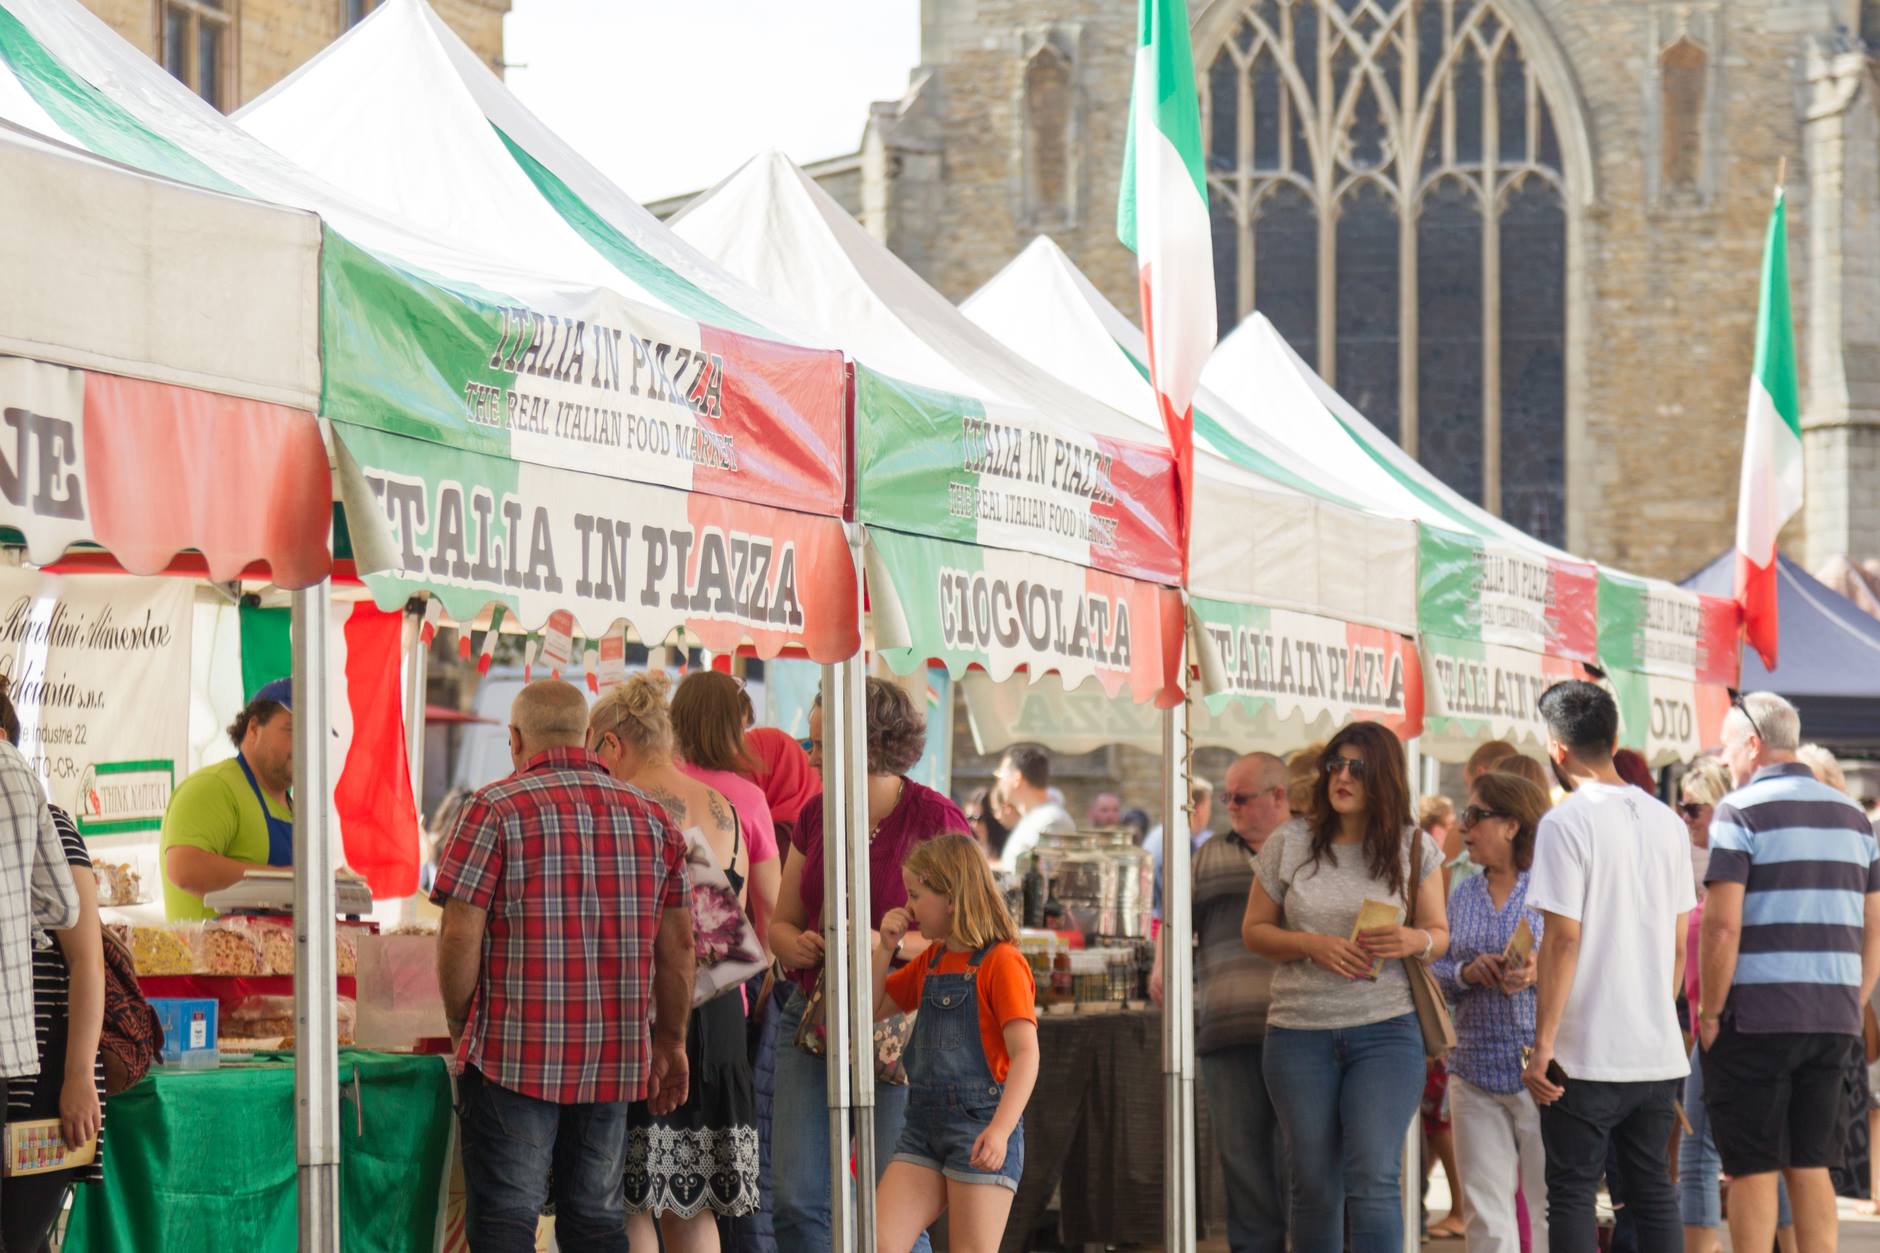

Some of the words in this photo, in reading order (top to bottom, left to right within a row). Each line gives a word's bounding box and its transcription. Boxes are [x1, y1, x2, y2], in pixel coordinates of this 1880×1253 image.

[489, 305, 585, 384] ITALIA
[592, 324, 622, 392] IN
[630, 334, 722, 417] PIAZZA
[465, 382, 501, 426] THE
[507, 391, 550, 435] REAL
[554, 401, 622, 447] ITALIAN
[627, 413, 670, 455] FOOD
[675, 424, 737, 471] MARKET
[963, 417, 1022, 480] ITALIA
[1027, 431, 1049, 485] IN
[1052, 438, 1114, 505] PIAZZA
[365, 474, 563, 594] TALIA
[574, 512, 632, 602] IN
[640, 525, 803, 626] PIAZZA
[950, 483, 973, 516] THE
[975, 488, 1002, 522] REAL
[1005, 494, 1047, 530] ITALIAN
[1049, 503, 1077, 539] FOOD
[1207, 628, 1296, 694] TALIA
[75, 724, 87, 745] 22
